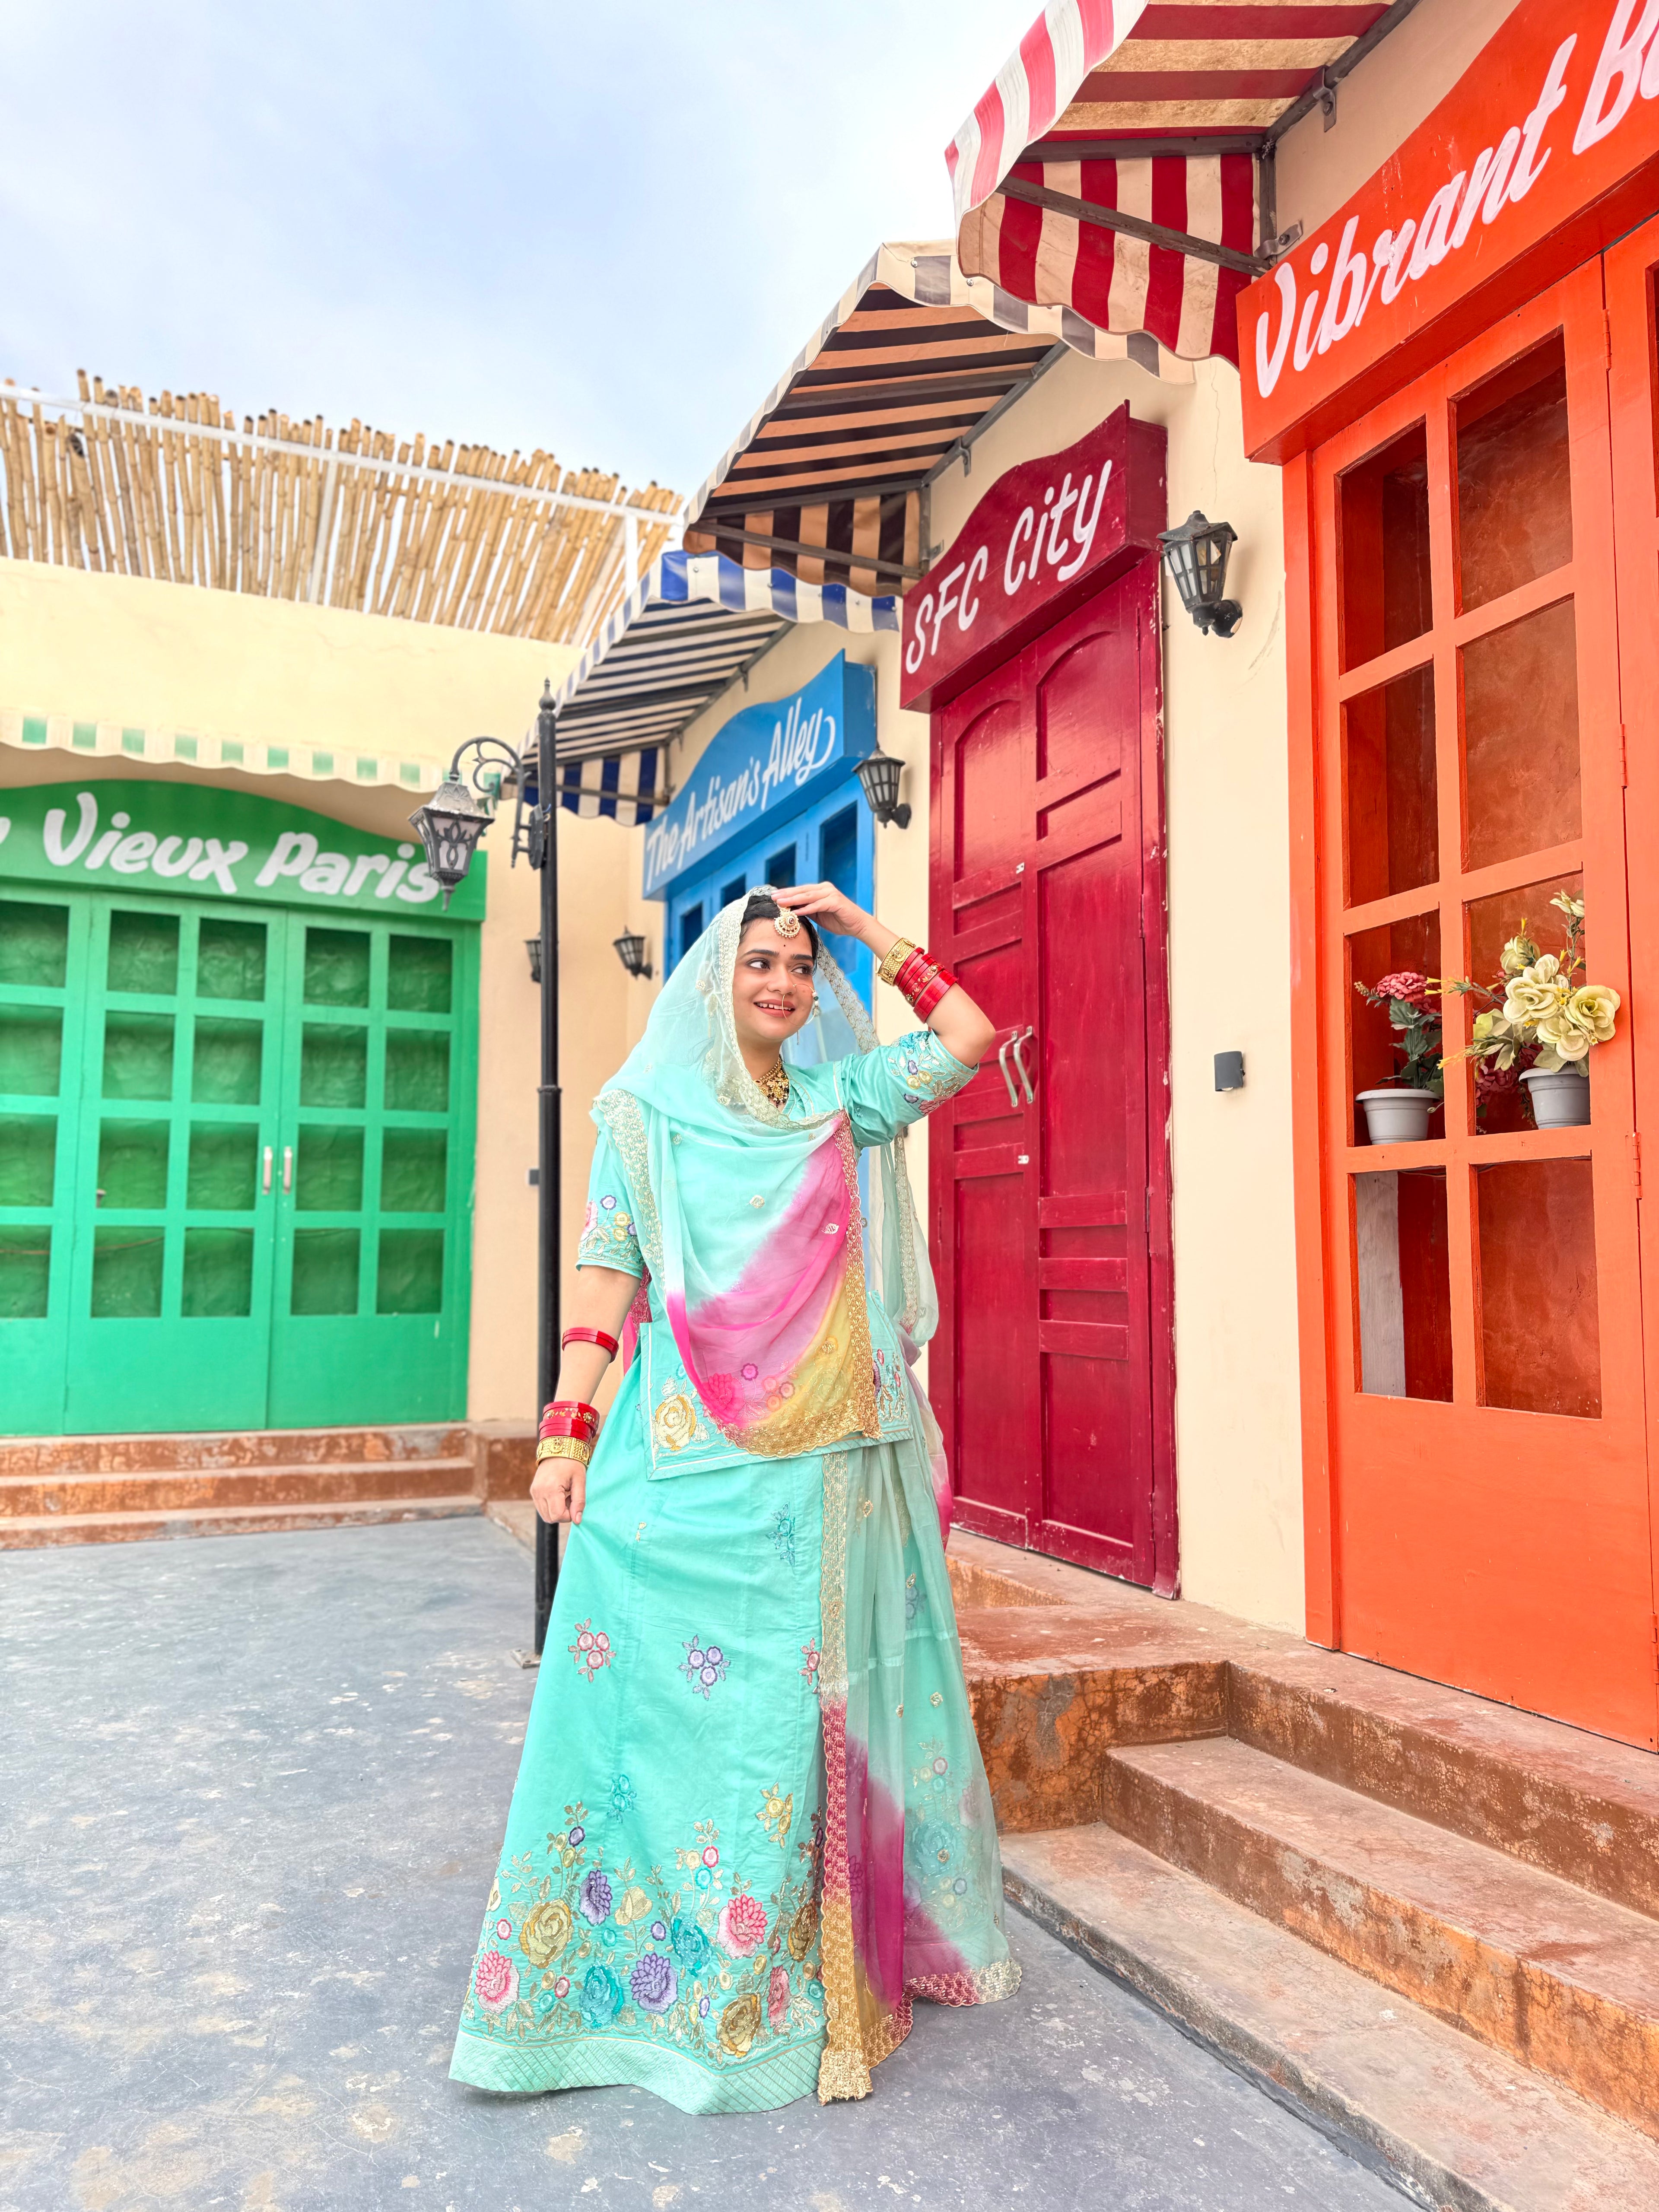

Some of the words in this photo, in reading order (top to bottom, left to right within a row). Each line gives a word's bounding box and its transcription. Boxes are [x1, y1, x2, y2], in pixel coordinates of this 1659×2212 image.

[1256, 33, 1577, 398] Vibrant
[1573, 0, 1659, 155] B
[906, 546, 988, 674] SFC
[1004, 460, 1112, 596] City
[43, 792, 248, 894] Vieux
[255, 831, 440, 903] Paris
[647, 816, 679, 891] The
[677, 756, 761, 870] Artisan's
[762, 697, 835, 811] Alley
